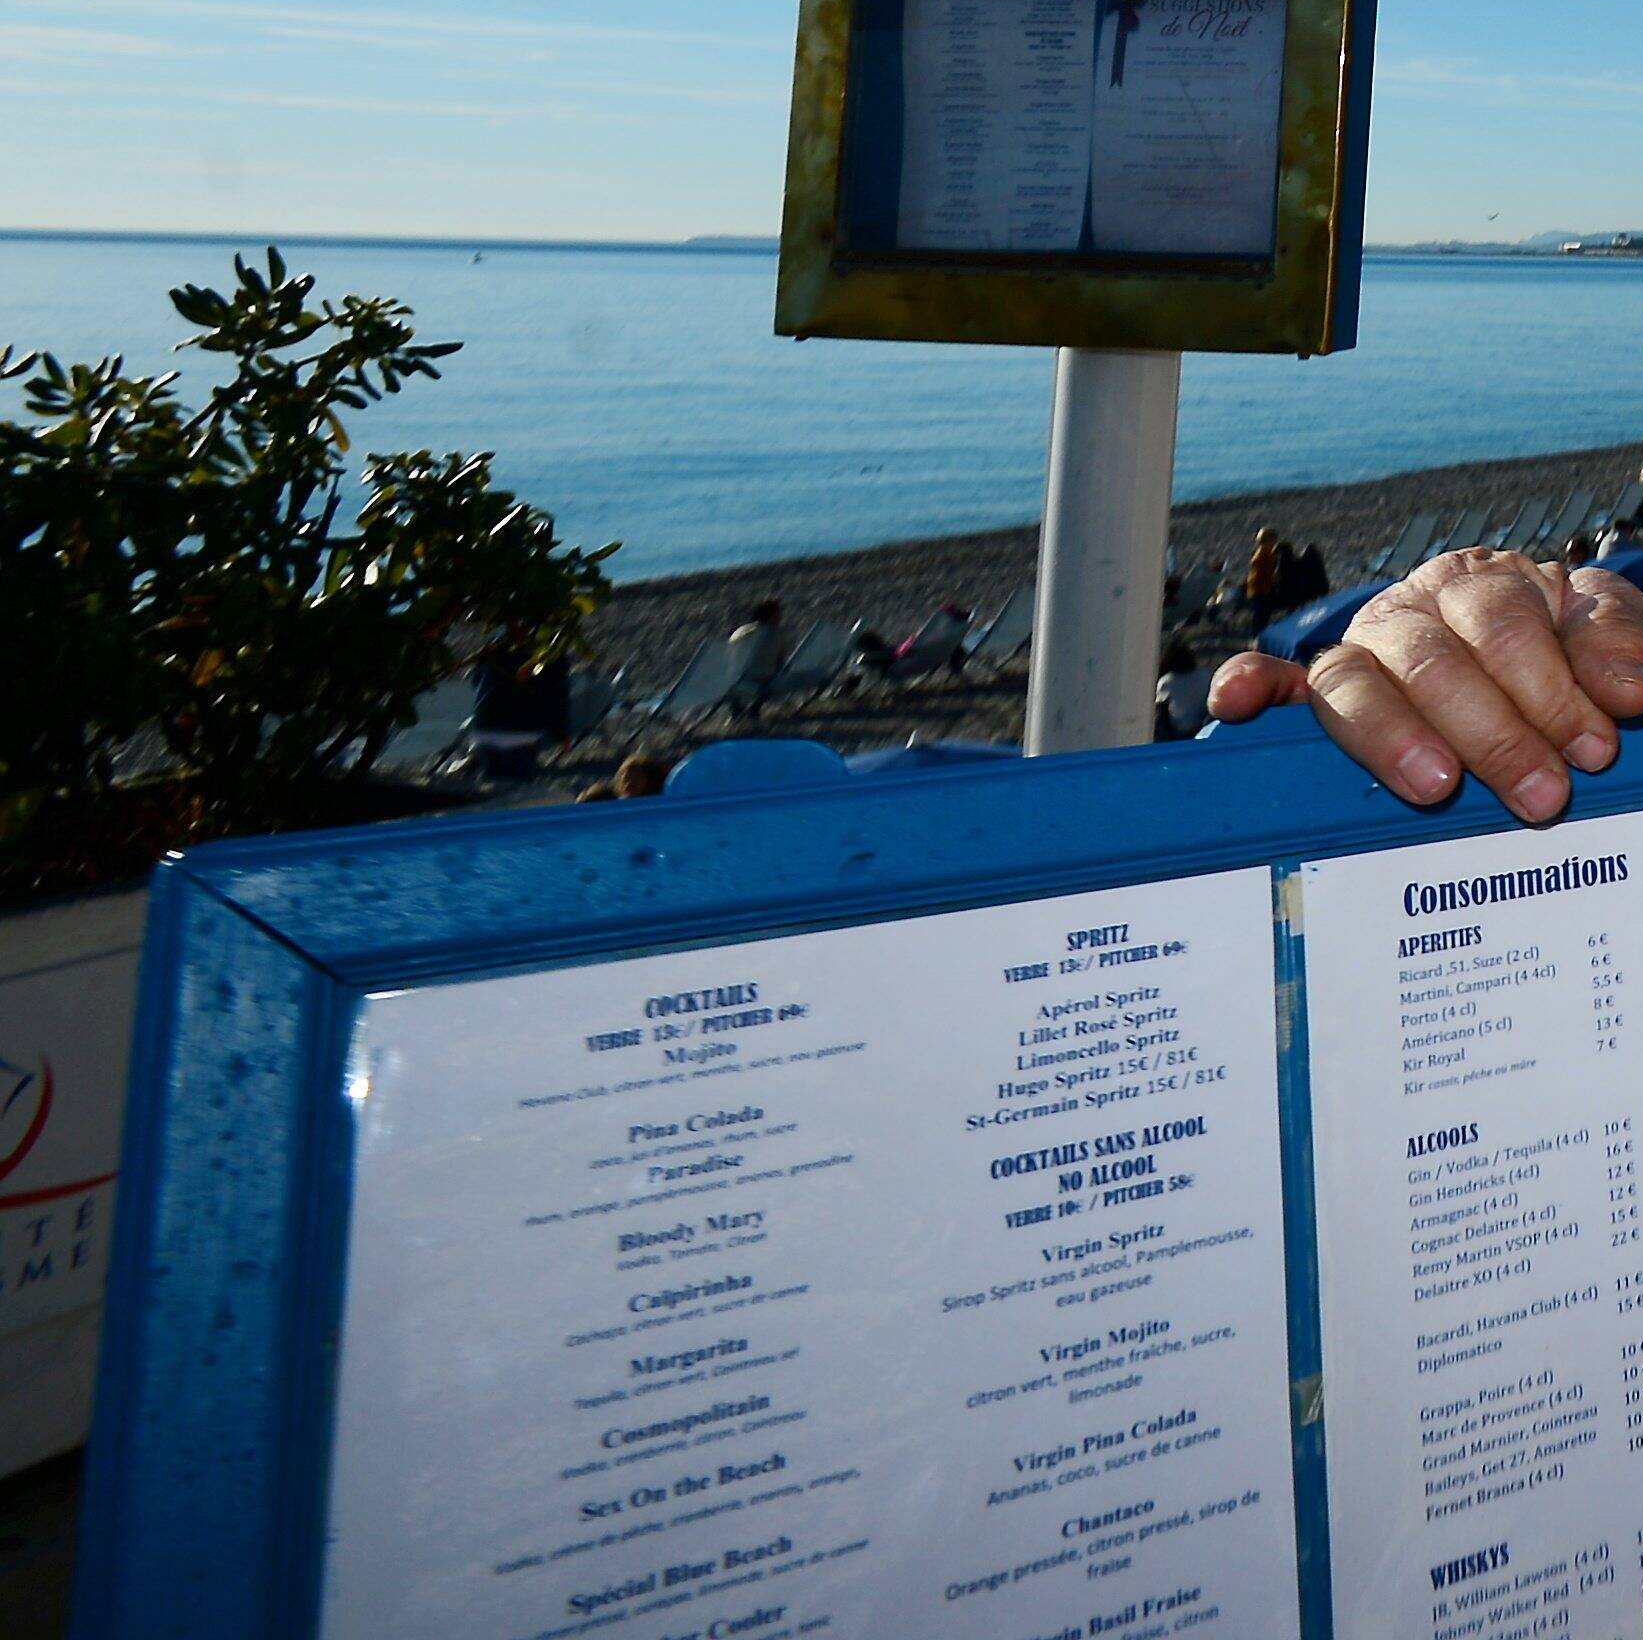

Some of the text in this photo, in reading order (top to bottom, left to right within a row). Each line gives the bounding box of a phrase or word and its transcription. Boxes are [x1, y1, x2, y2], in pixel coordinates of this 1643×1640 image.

[1403, 853, 1628, 917] Consommations
[1067, 923, 1128, 951] SPRITZ
[1397, 925, 1482, 958] APERITIFS
[1401, 1001, 1476, 1028] Porto (4 cl)
[1401, 1016, 1512, 1051] Américano (5 cl)
[1016, 1030, 1179, 1071] Limoncello Spritz
[1403, 1047, 1465, 1072] Kir Royal
[998, 1046, 1197, 1099] Hugo Spritz 15€ 81€
[965, 1065, 1225, 1131] St-Germain Spritz 15€ 81€
[990, 1115, 1207, 1180] COCKTAILS SANS ALCOOL
[1406, 1122, 1479, 1159] ALCOOLS
[1058, 1154, 1157, 1194] NO ALCOOL
